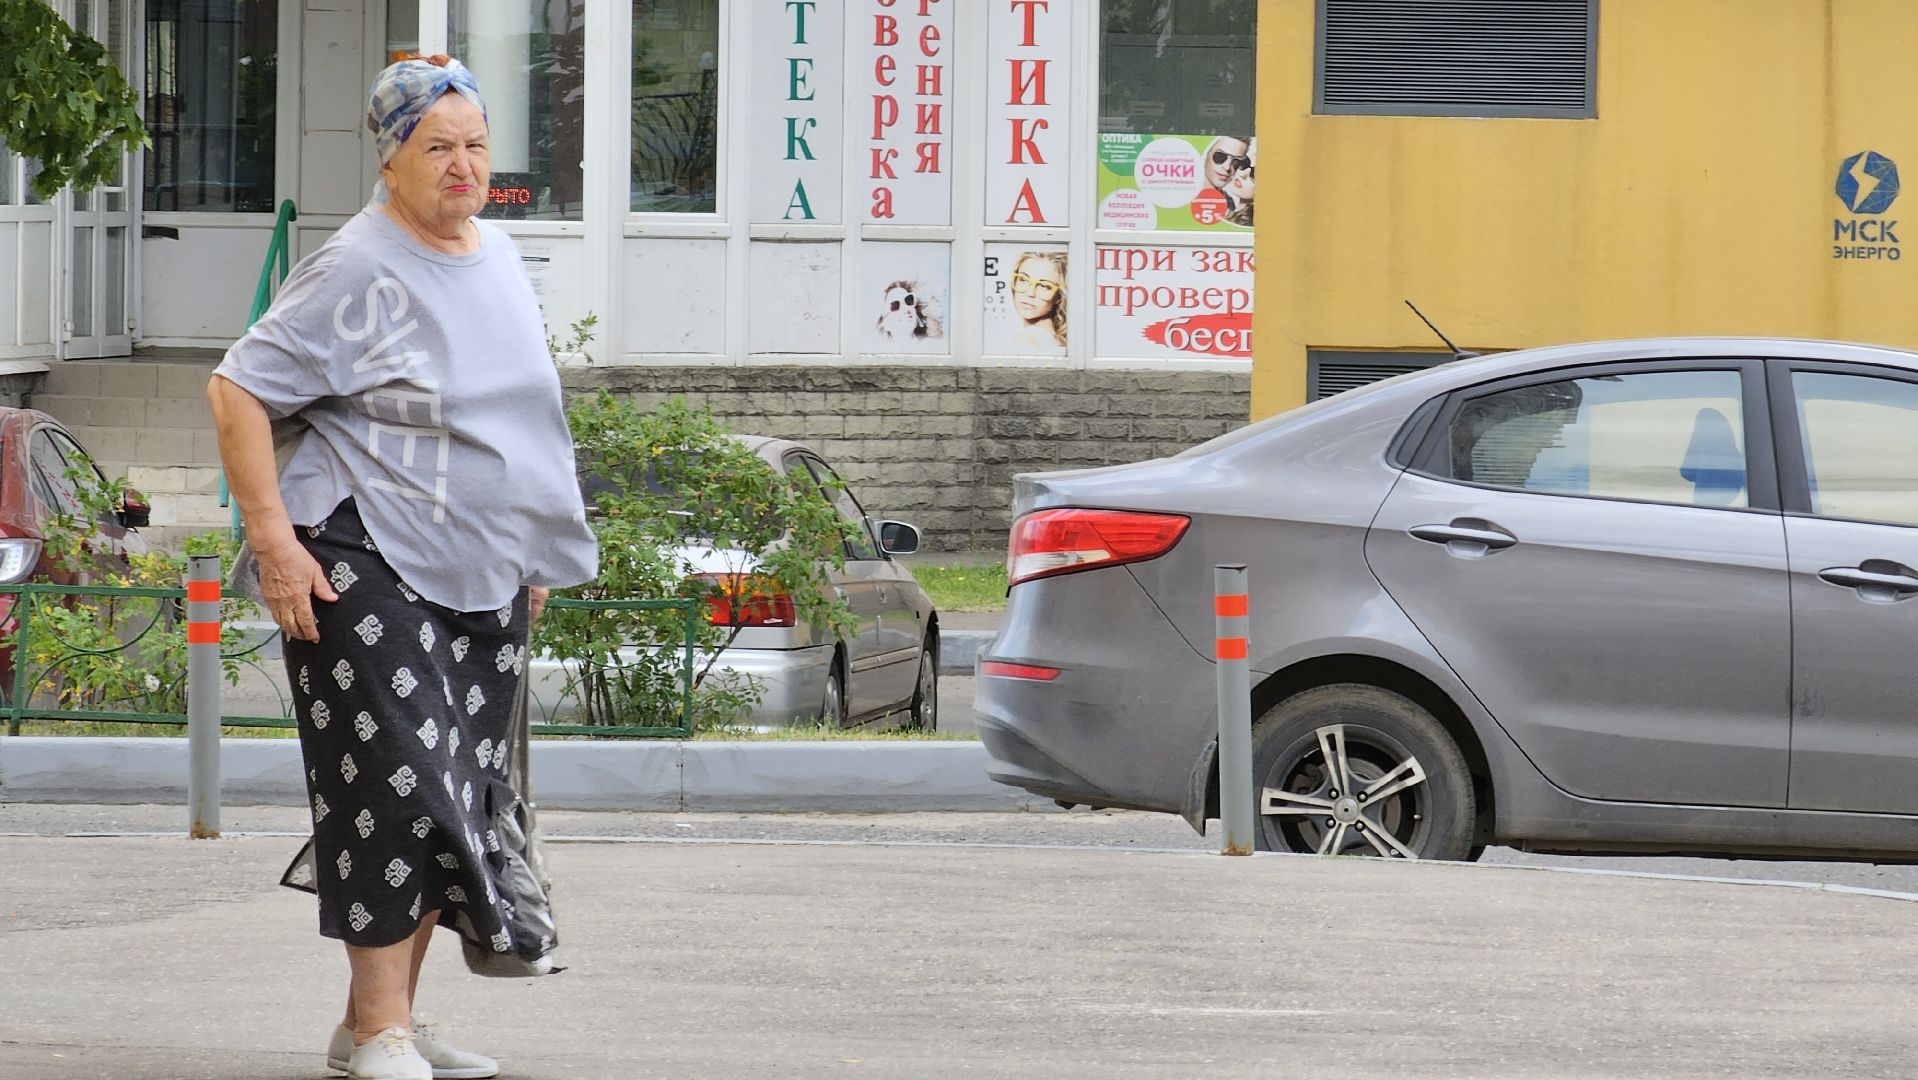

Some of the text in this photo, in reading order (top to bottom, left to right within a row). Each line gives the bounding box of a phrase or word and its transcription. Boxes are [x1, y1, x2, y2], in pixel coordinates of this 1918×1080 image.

[782, 1, 817, 220] ТЕКА
[869, 0, 899, 219] верка
[1005, 0, 1052, 224] ТИКА
[1102, 133, 1142, 144] ОПТИКА
[1142, 164, 1195, 178] ОЧКИ
[1833, 218, 1899, 243] МСК
[1096, 248, 1255, 280] при зак
[1832, 245, 1901, 261] ЭНЕРГО
[984, 256, 999, 277] E
[995, 280, 1006, 294] P
[1096, 284, 1254, 320] провер
